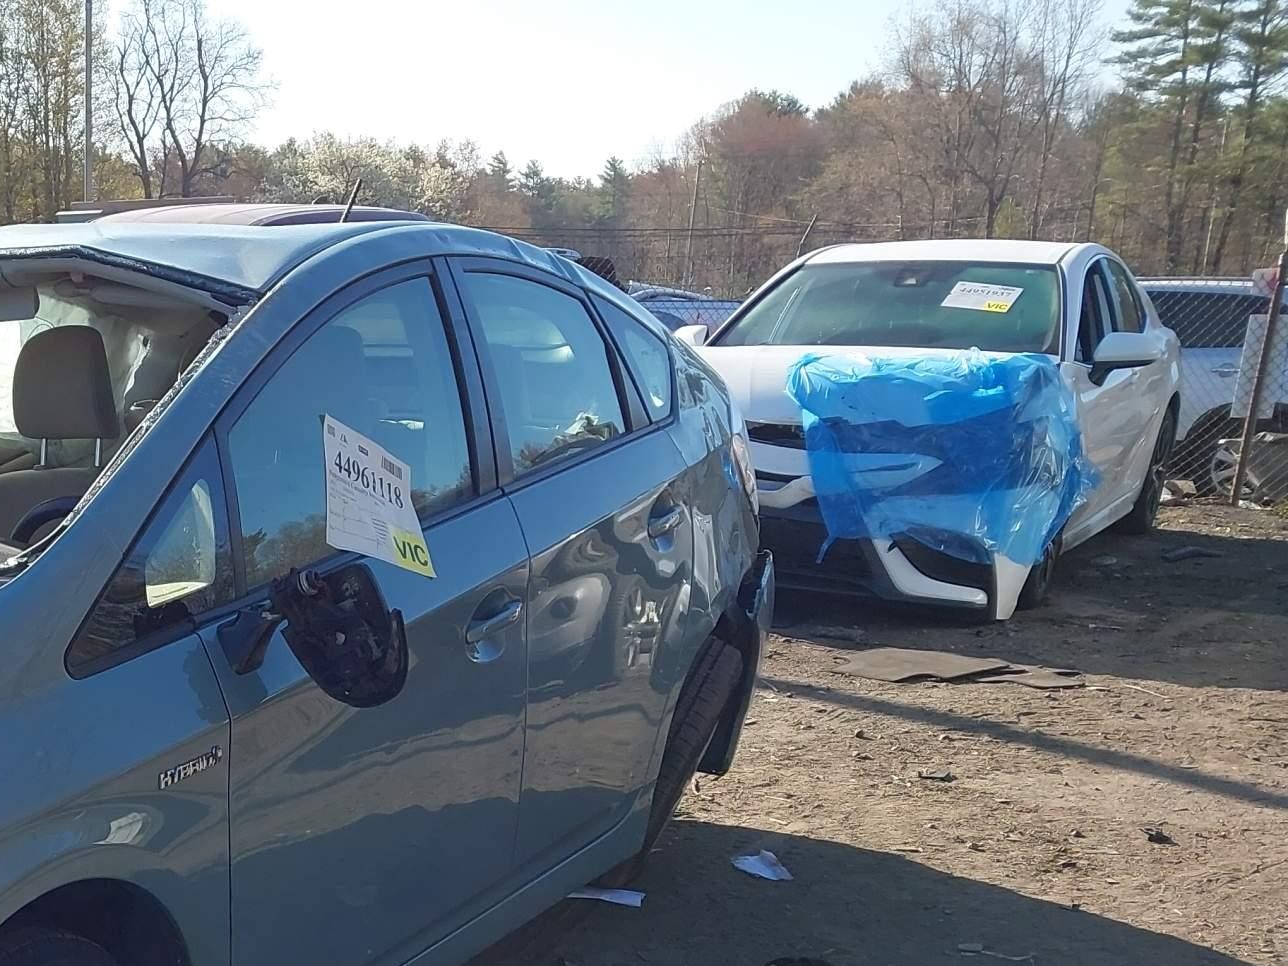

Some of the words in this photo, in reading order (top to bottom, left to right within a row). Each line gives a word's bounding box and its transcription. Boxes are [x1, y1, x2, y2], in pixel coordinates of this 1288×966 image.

[986, 302, 1008, 310] VIC
[334, 451, 404, 509] 44961118
[393, 535, 429, 567] VIC
[158, 746, 223, 790] HYBRID
